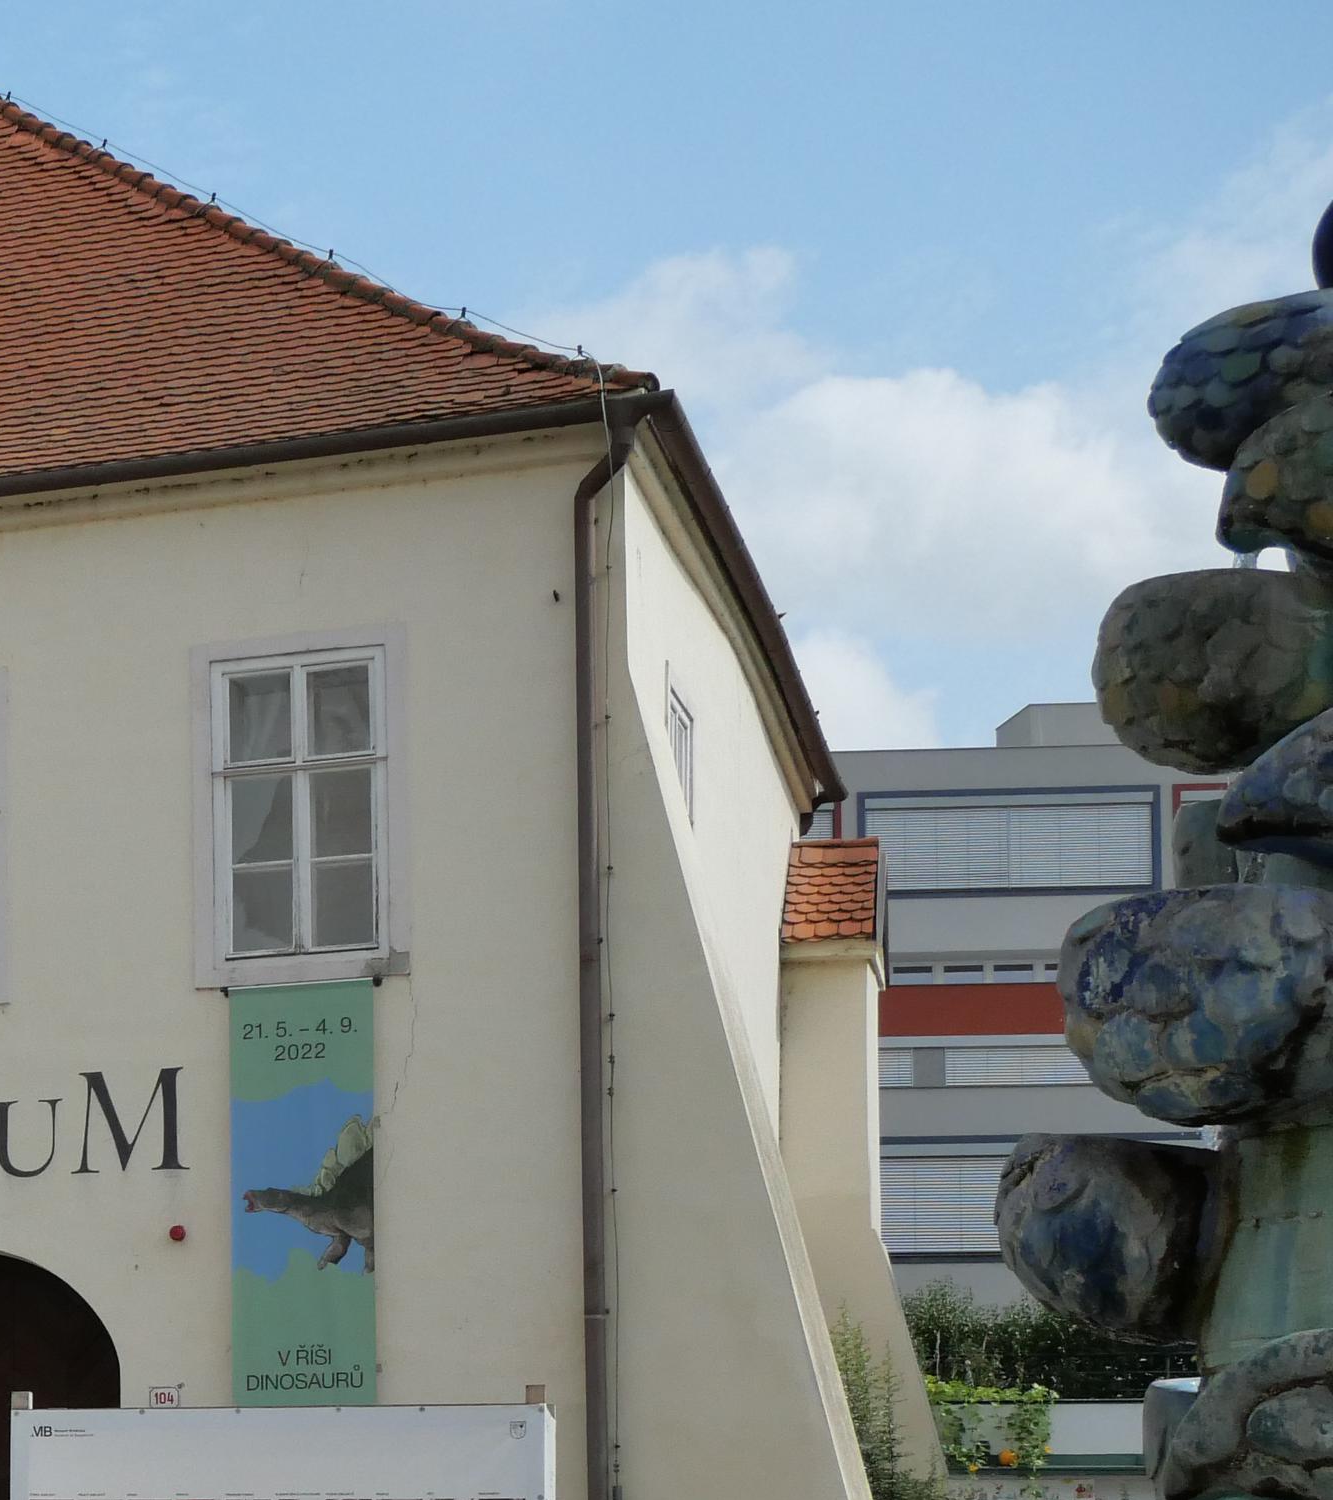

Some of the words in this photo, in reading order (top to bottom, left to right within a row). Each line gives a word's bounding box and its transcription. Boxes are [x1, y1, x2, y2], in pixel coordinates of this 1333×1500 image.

[242, 1023, 269, 1040] 21.
[276, 1021, 293, 1038] 5.
[315, 1018, 333, 1035] 4.
[340, 1016, 358, 1034] 9.
[274, 1042, 326, 1062] 2022
[277, 1350, 291, 1367] V
[296, 1344, 332, 1366] ŘÍŠI
[246, 1364, 364, 1391] DINOSAURŮ
[154, 1392, 174, 1405] 104
